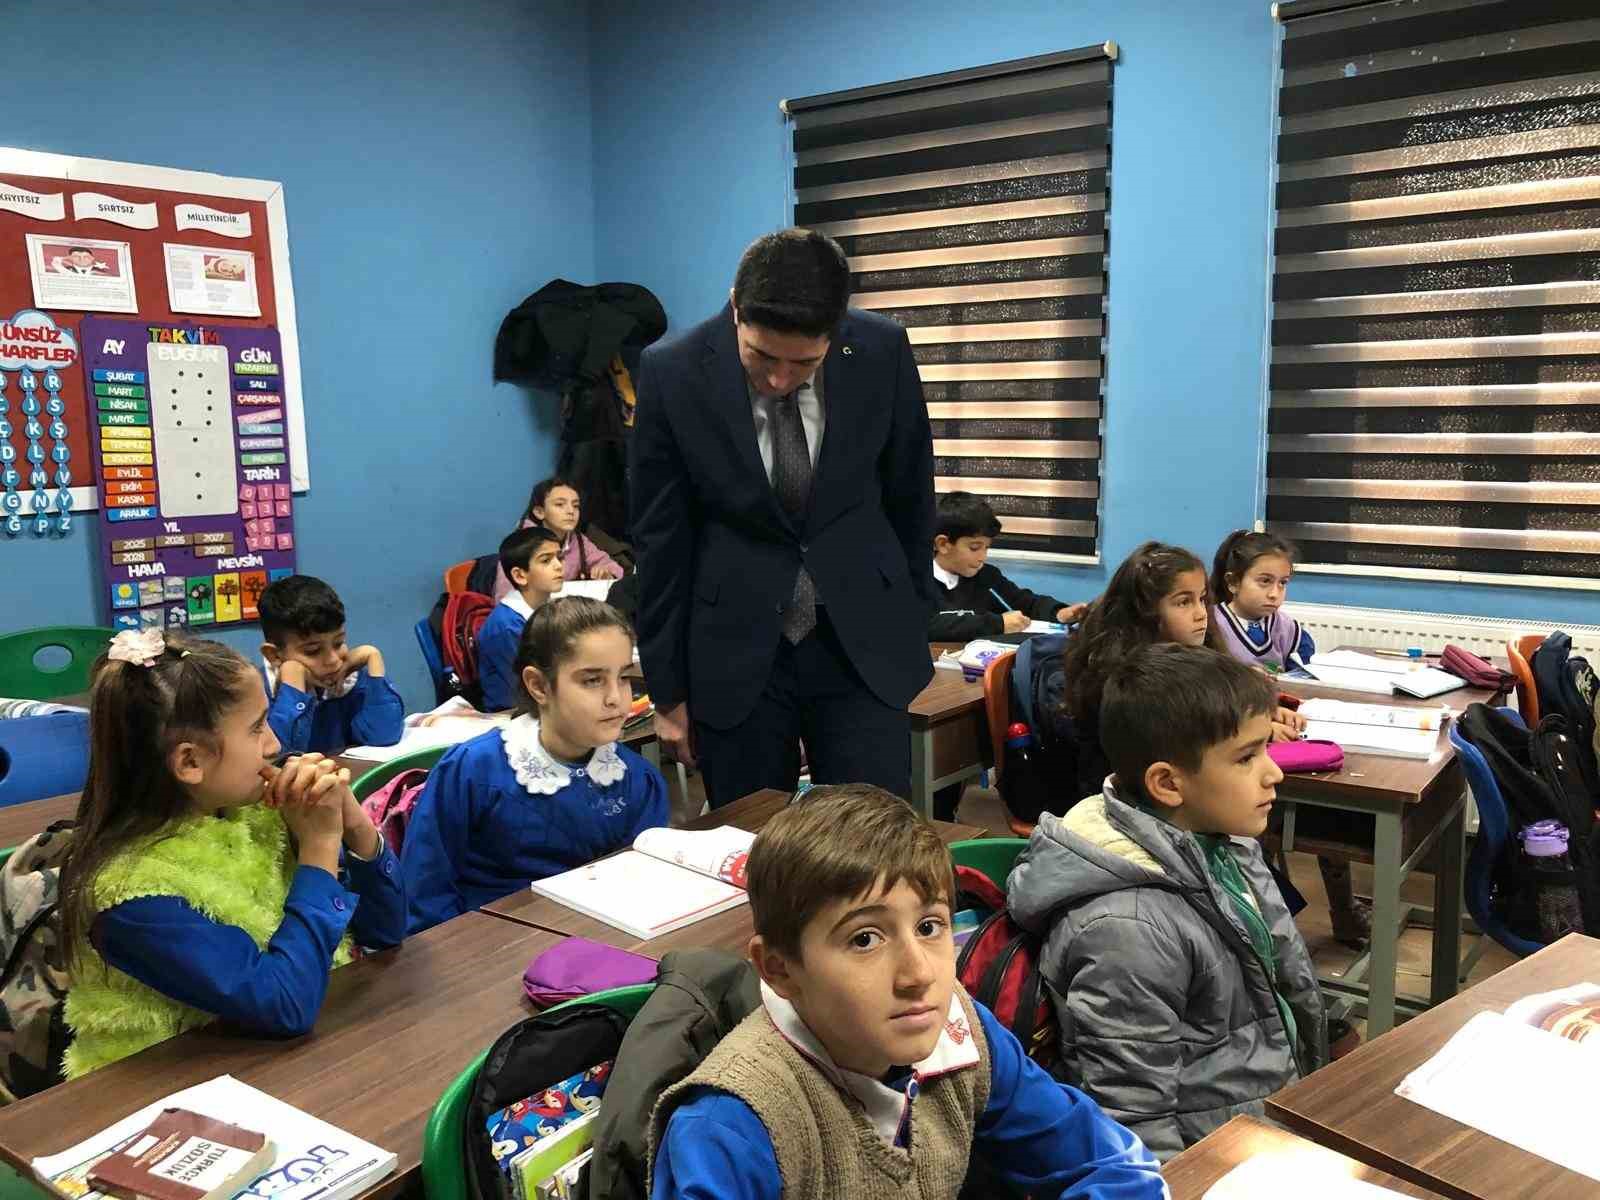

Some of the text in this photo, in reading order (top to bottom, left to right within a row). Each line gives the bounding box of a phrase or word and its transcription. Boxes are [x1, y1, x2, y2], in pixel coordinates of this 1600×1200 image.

[3, 323, 61, 343] ÜNSÜZ
[148, 327, 220, 344] TAKVİM
[102, 339, 126, 355] AY
[240, 347, 272, 363] GÜN
[23, 375, 59, 388] H R
[105, 372, 136, 382] ŞUBAT
[108, 386, 133, 396] MART
[28, 398, 60, 412] J S
[110, 399, 137, 409] NİSAN
[29, 422, 41, 435] K
[55, 422, 65, 438] Ş
[2, 446, 68, 459] D L T
[7, 471, 70, 484] F M V
[244, 466, 280, 480] TARİH
[7, 494, 70, 507] G N Y
[117, 496, 145, 505] KASIM
[120, 508, 151, 518] ARALIK
[9, 515, 71, 532] Ğ P Z
[164, 522, 181, 533] YIL
[217, 554, 264, 569] MEVSİM
[128, 563, 166, 577] HAVA
